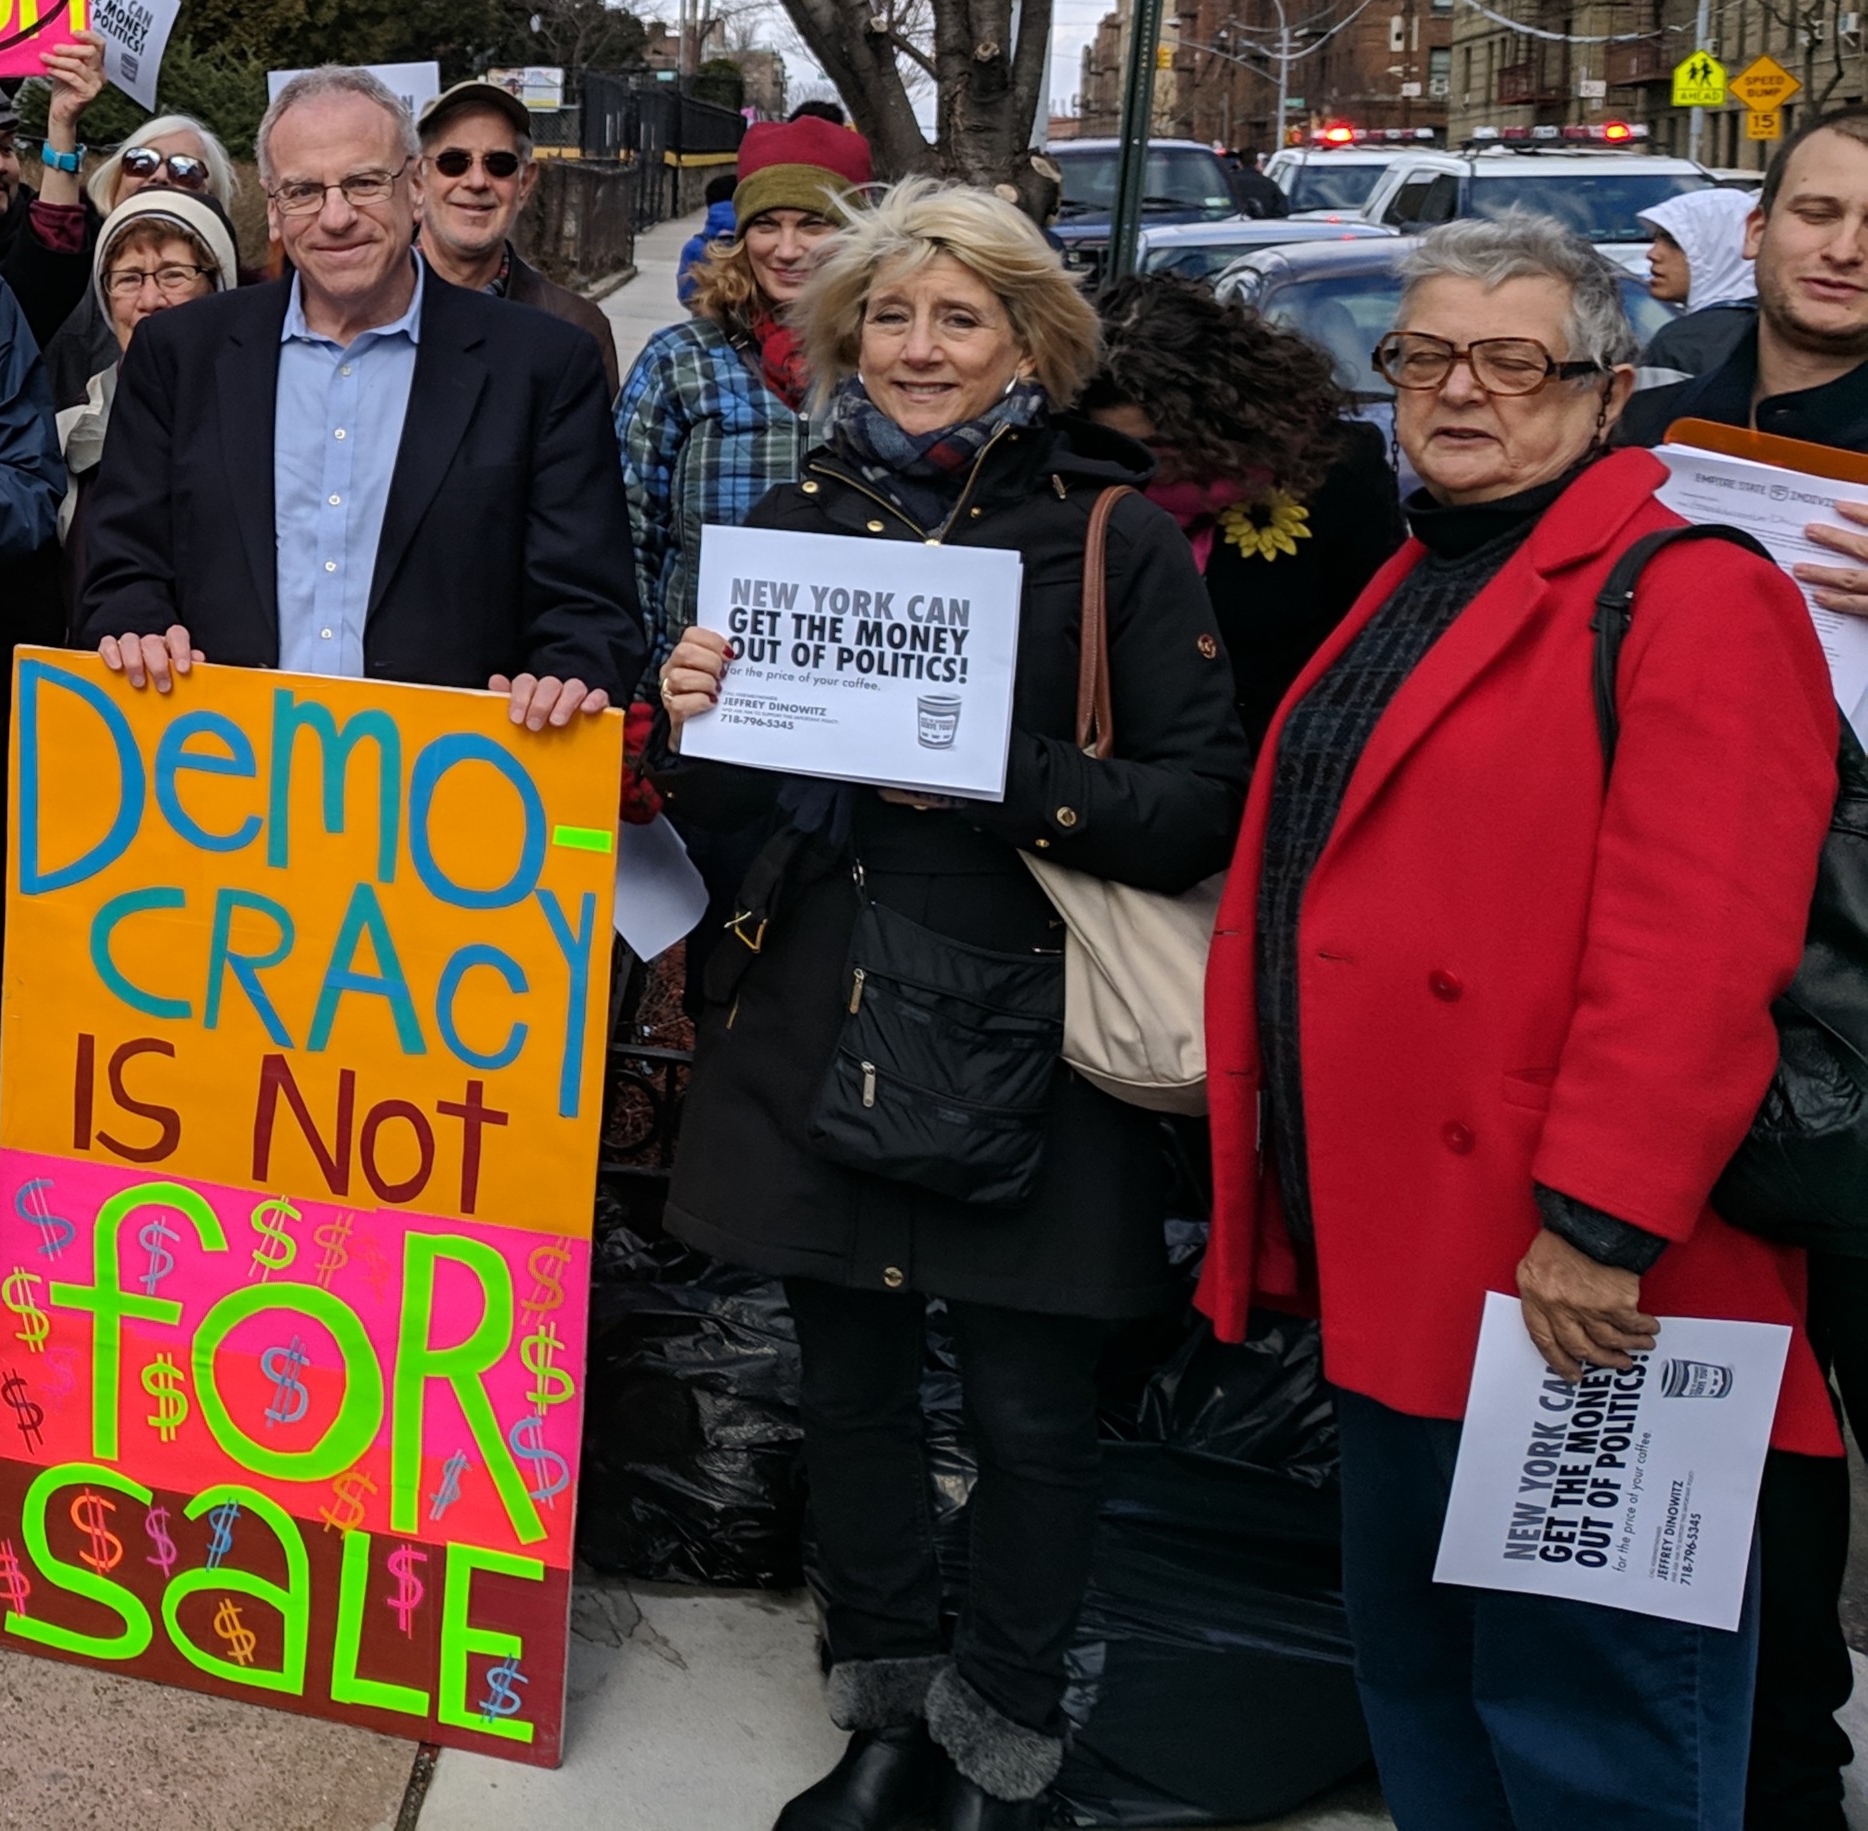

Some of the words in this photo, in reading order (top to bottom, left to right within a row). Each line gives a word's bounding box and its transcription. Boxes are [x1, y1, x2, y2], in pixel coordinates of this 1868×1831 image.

[93, 9, 145, 56] POLITICS!
[104, 0, 148, 41] MONEY
[128, 0, 153, 28] CAN
[1745, 76, 1784, 86] SPEED
[1747, 88, 1781, 97] BUMP
[1753, 114, 1774, 128] 15
[730, 578, 799, 610] NEW
[810, 585, 895, 620] YORK
[907, 595, 970, 627] CAN
[728, 607, 781, 637] GET
[791, 613, 843, 644] THE
[855, 620, 969, 656] MONEY
[729, 636, 781, 664] OUT
[791, 643, 826, 669] OF
[836, 647, 968, 684] POLITICS!
[745, 666, 763, 678] the
[765, 671, 794, 684] price
[799, 672, 812, 683] of
[812, 676, 838, 688] your
[842, 679, 881, 692] coffee.
[720, 713, 794, 730] 718-796-5345
[723, 697, 765, 710] JEFFREY
[769, 702, 827, 716] DINOWITZ
[73, 1032, 181, 1163] IS
[1518, 1421, 1568, 1493] YORK
[1550, 1464, 1592, 1508] THE
[1587, 1477, 1621, 1508] OF
[1627, 1492, 1639, 1506] of
[1632, 1466, 1645, 1491] your
[1624, 1505, 1637, 1534] price
[1664, 1480, 1684, 1536] DINOWITZ
[1503, 1502, 1547, 1560] NEW
[1539, 1516, 1579, 1563] GET
[1574, 1516, 1614, 1568] OUT
[1616, 1534, 1631, 1556] the
[1680, 1513, 1701, 1586] 718-796-5345
[1612, 1554, 1627, 1572] for
[1657, 1539, 1673, 1580] JEFFREY
